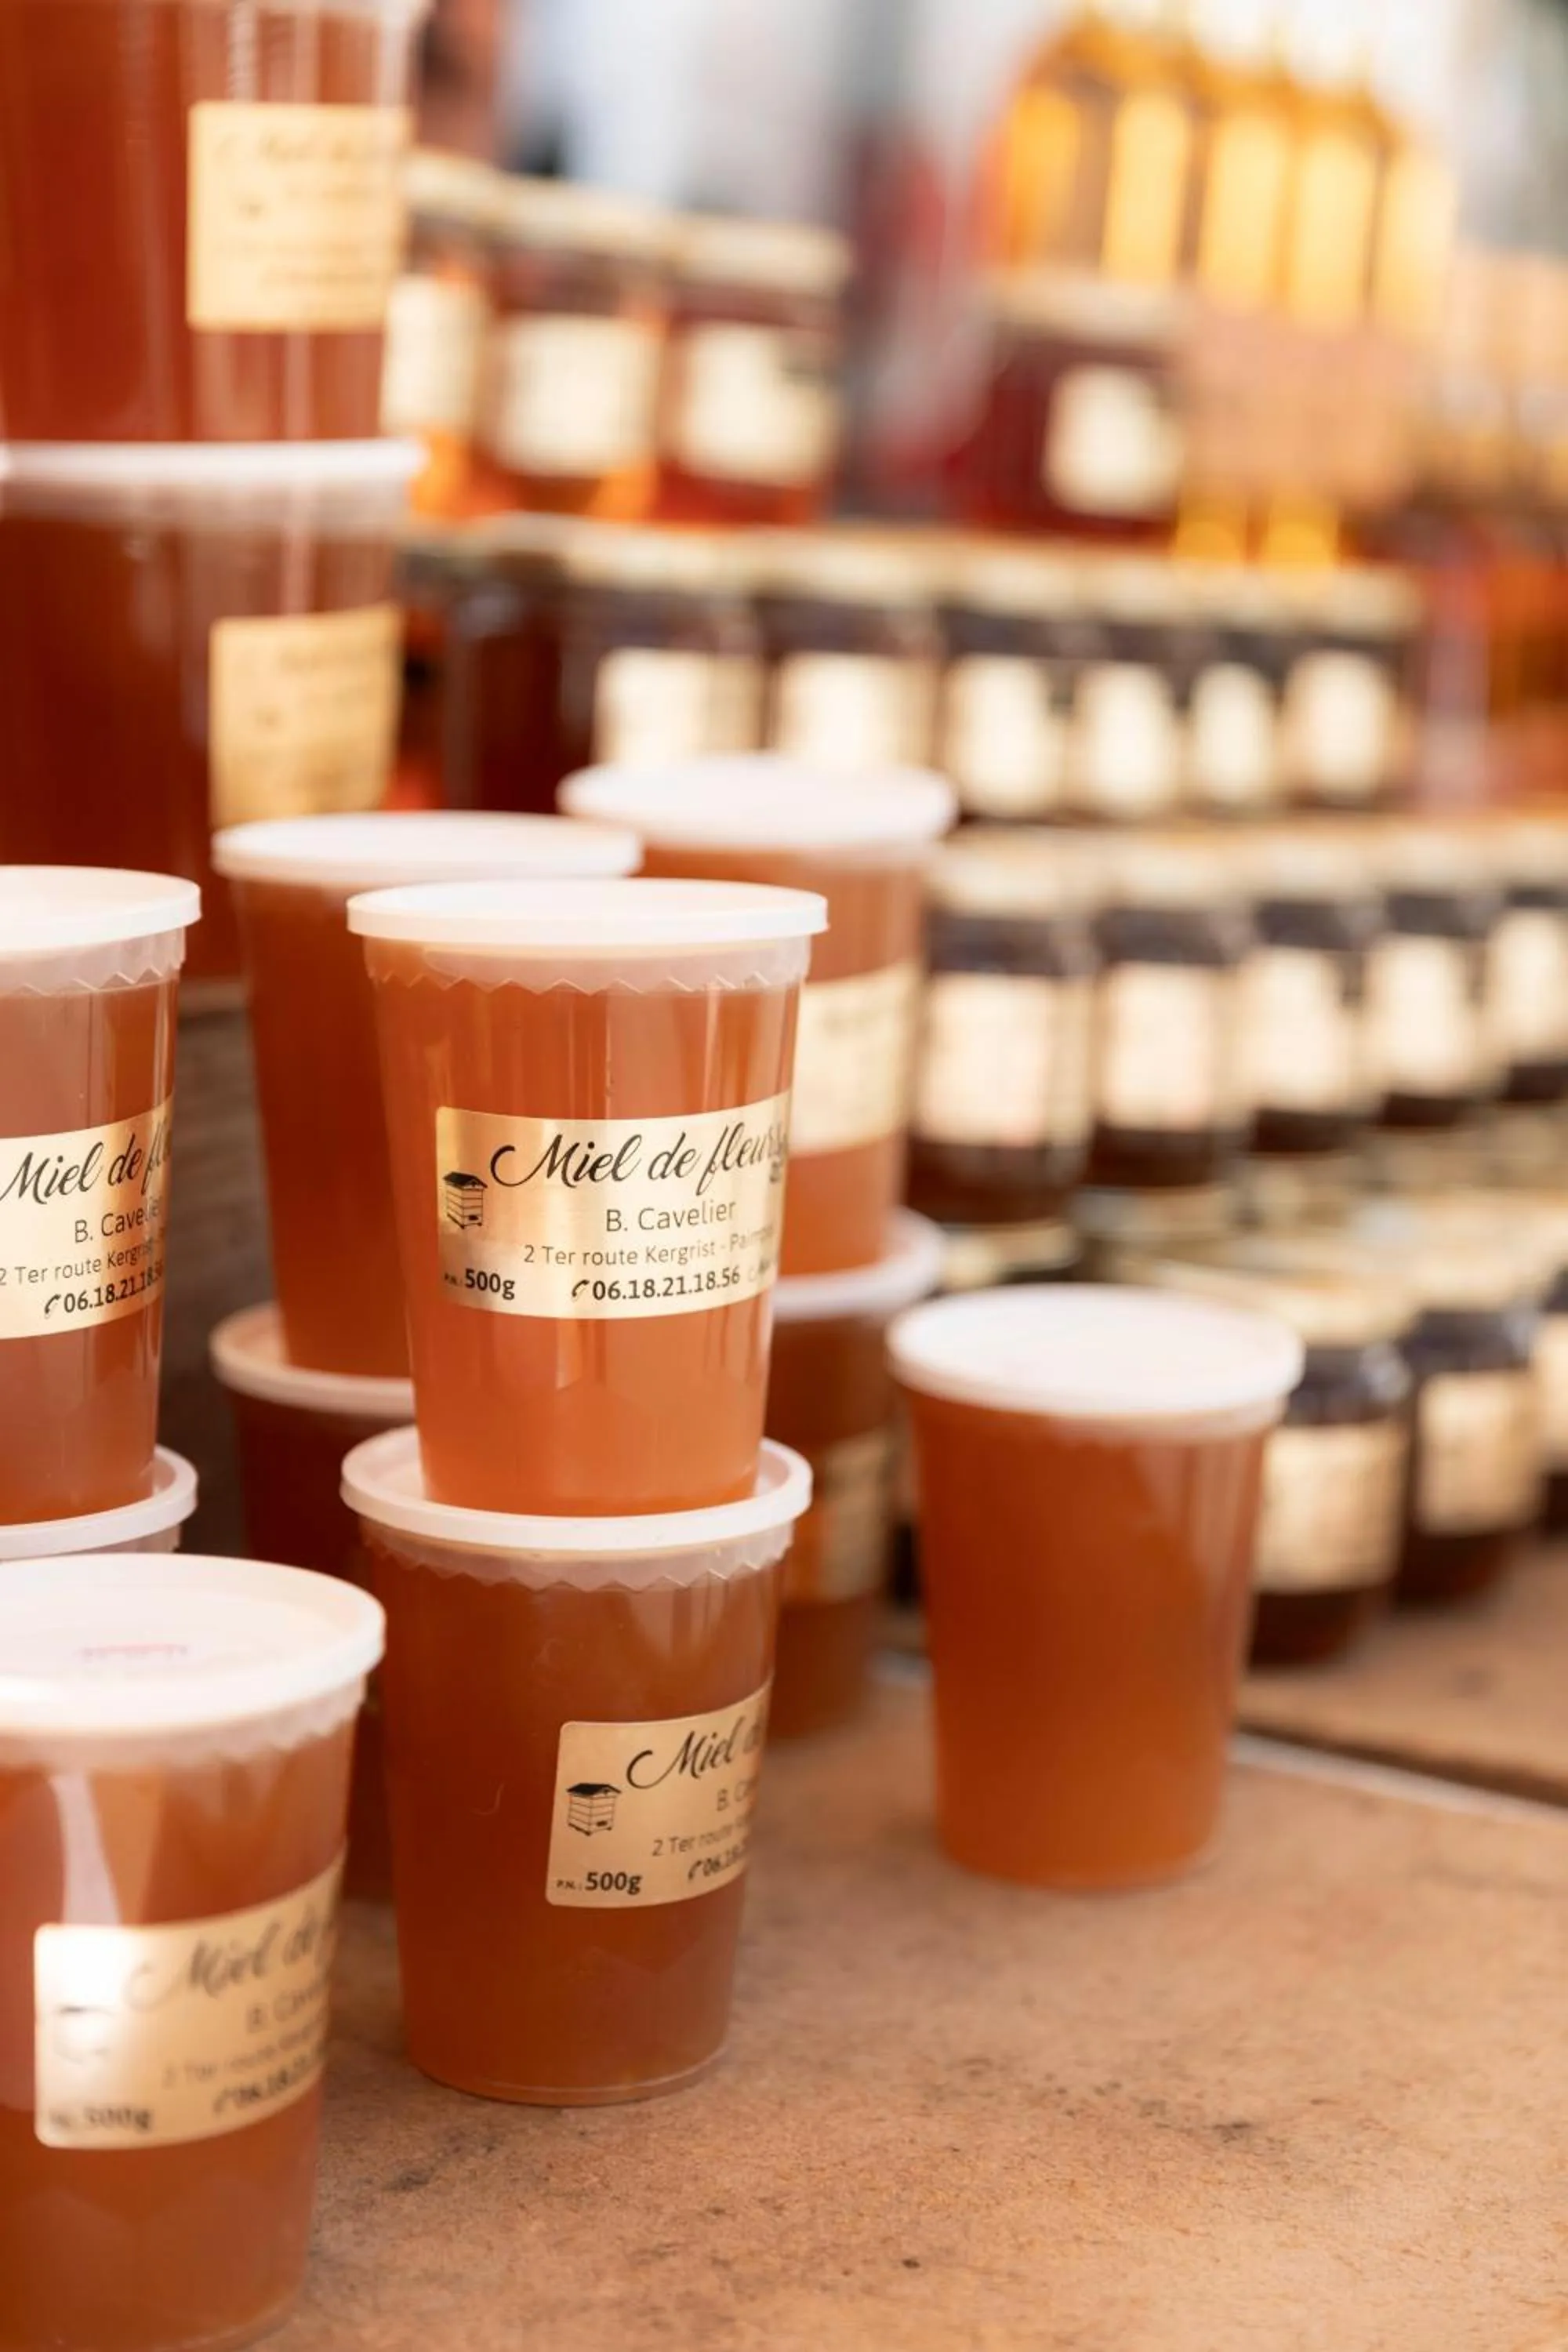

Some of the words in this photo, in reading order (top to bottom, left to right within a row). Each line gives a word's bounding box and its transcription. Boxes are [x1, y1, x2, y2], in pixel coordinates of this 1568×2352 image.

[0, 1141, 103, 1205] Miel
[107, 1134, 144, 1187] de
[490, 1134, 642, 1188] Miel
[648, 1132, 701, 1180] de
[74, 1218, 93, 1243] B.
[606, 1208, 628, 1232] B.
[639, 1198, 736, 1231] Cavelier
[524, 1245, 535, 1263] 2
[542, 1245, 576, 1265] Ter
[583, 1245, 637, 1266] route
[645, 1239, 715, 1267] Kergrist
[14, 1266, 49, 1286] Ter
[55, 1258, 101, 1282] route
[465, 1268, 515, 1301] 500g
[593, 1265, 741, 1301] 06.18.21.18.56
[626, 1715, 746, 1790] Miel
[652, 1839, 664, 1857] 2
[668, 1835, 695, 1855] Ter
[584, 1871, 643, 1895] 500g
